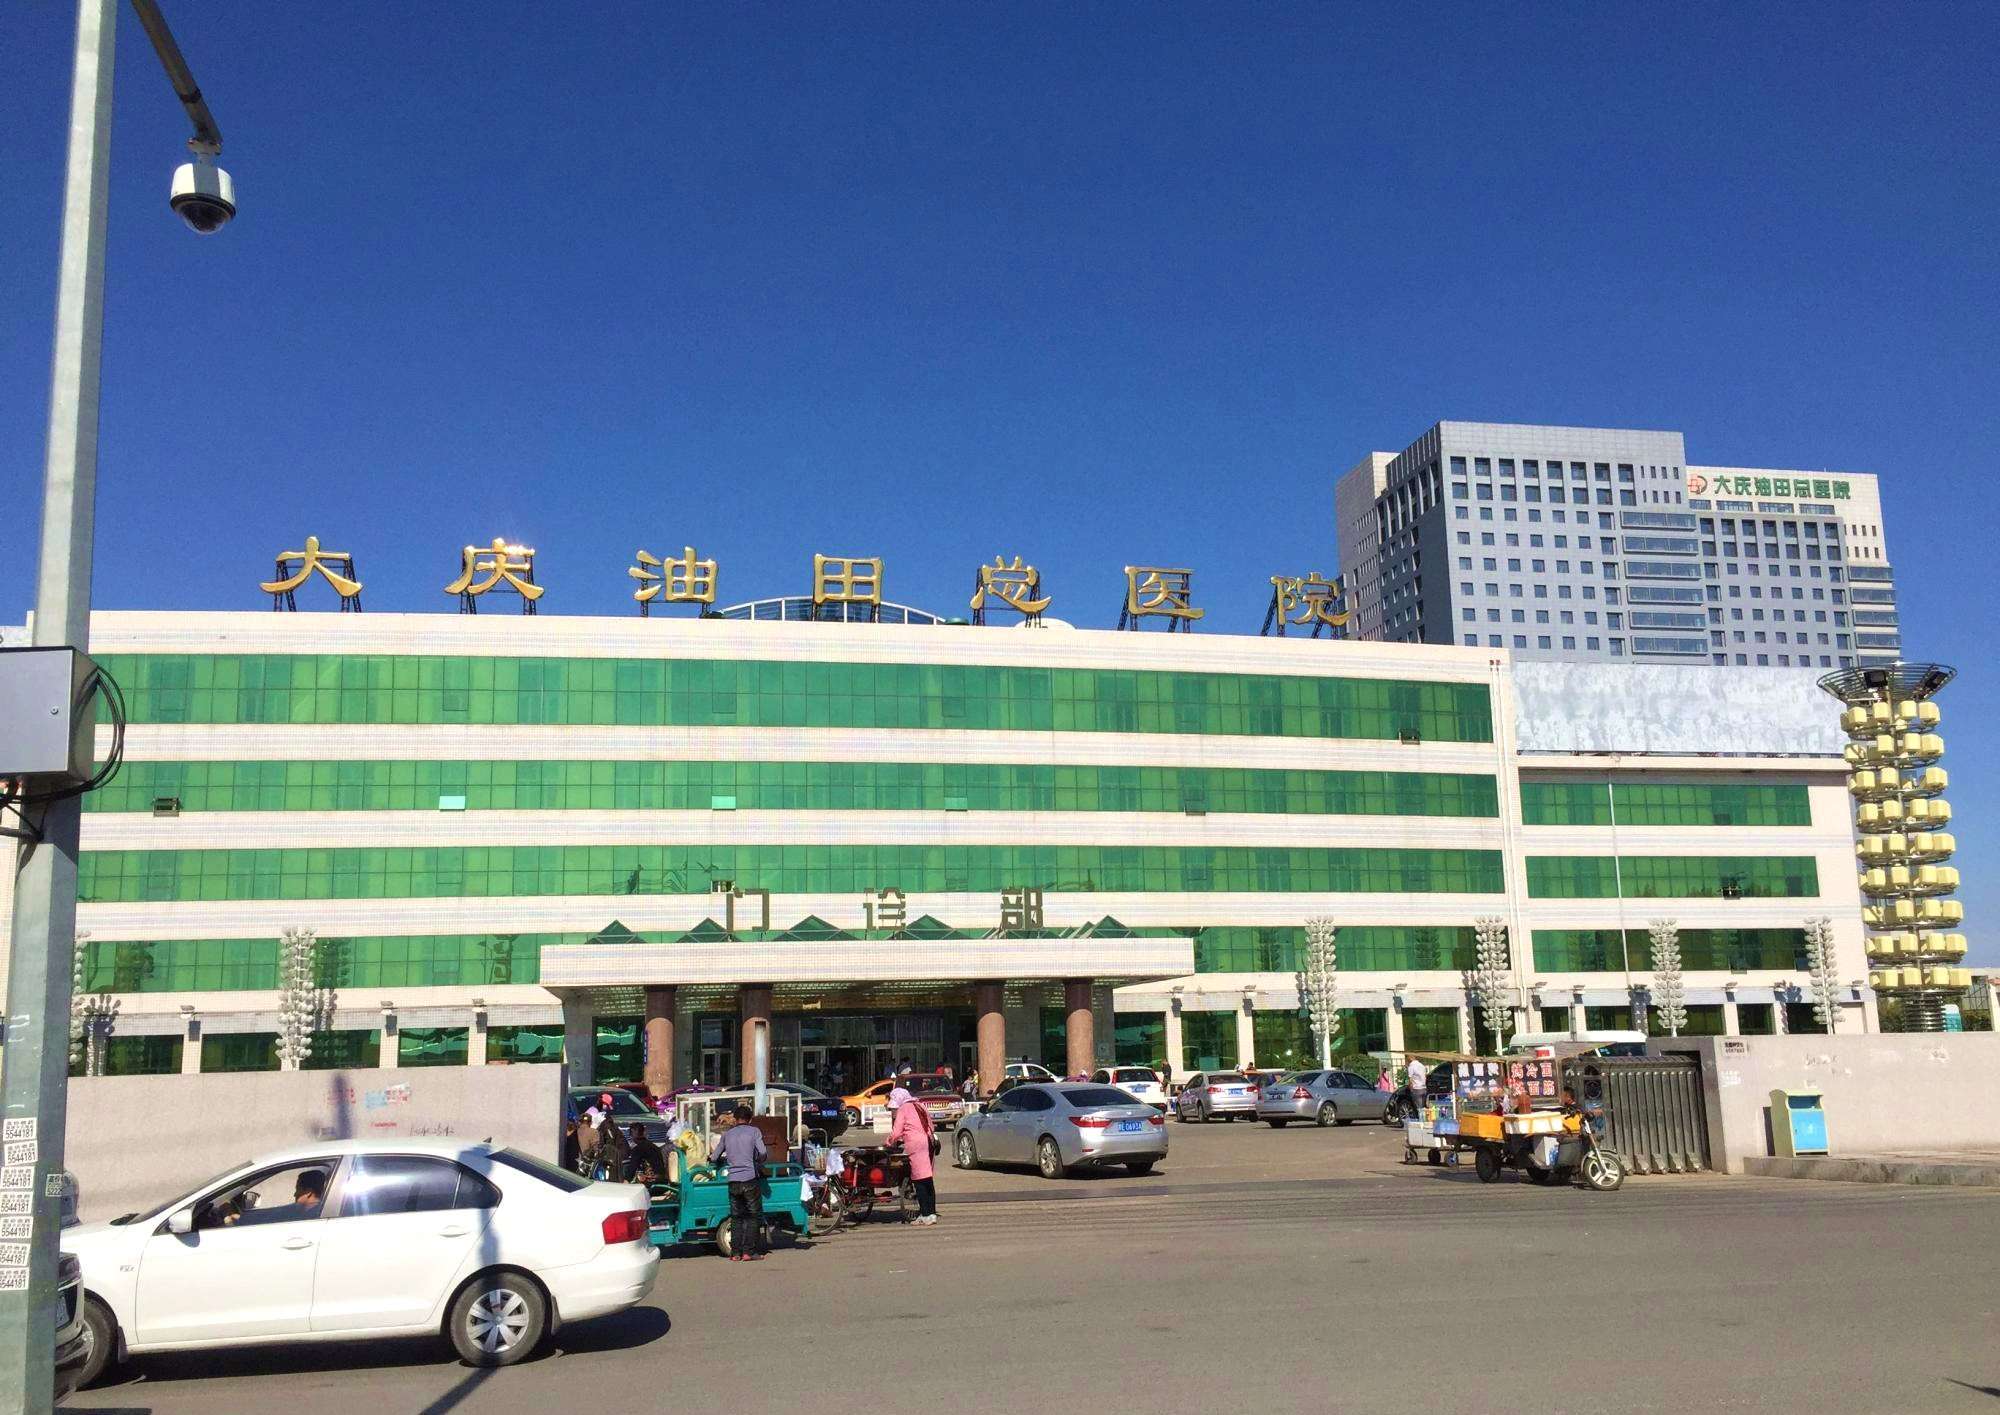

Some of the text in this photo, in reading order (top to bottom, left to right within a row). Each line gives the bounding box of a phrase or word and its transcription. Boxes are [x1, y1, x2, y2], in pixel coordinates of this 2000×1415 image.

[1713, 475, 1851, 499] 大庆油田总医院
[259, 535, 1350, 628] 大庆油田总医院
[726, 887, 1043, 932] 门诊部
[5, 1128, 33, 1139] 5544181
[8, 1151, 36, 1164] 5544181
[2, 1177, 31, 1188] 5544181
[0, 1202, 29, 1213] 5544181
[1, 1227, 30, 1237] 5544181
